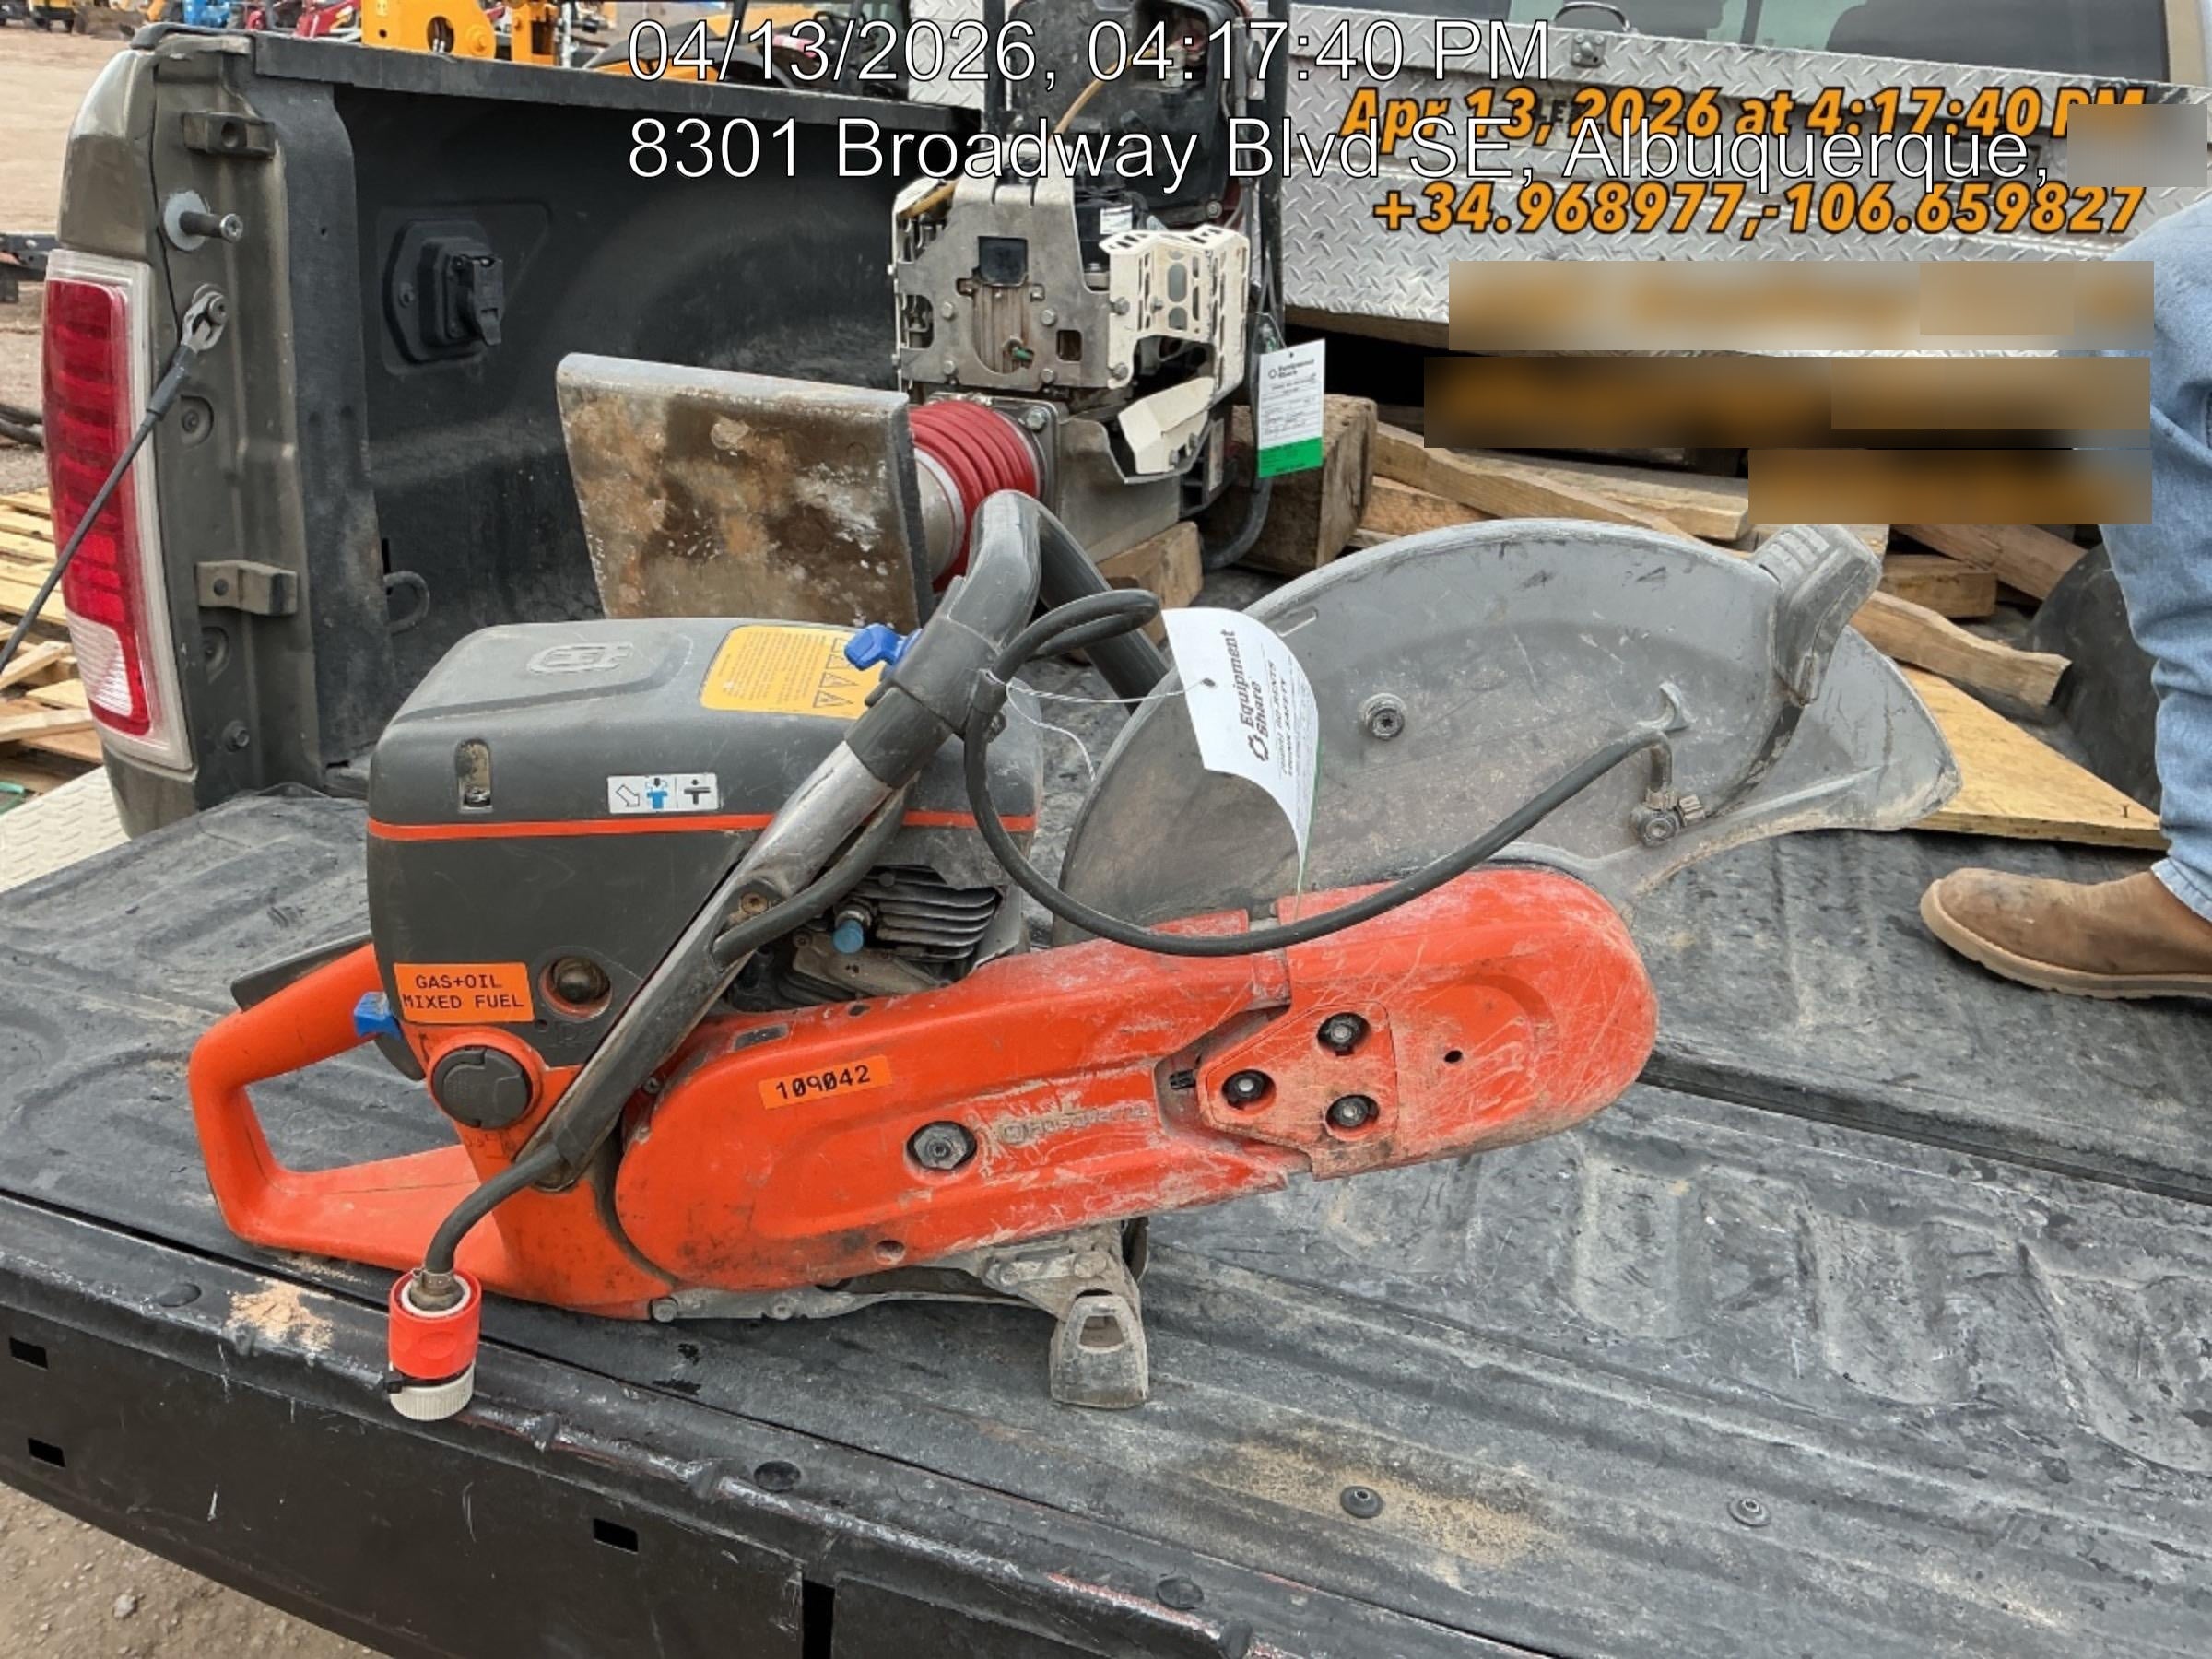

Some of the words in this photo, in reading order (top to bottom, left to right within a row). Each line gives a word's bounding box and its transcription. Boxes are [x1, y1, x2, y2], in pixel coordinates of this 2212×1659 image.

[1220, 629, 1254, 729] Equipment
[1251, 681, 1270, 738] Share
[415, 974, 502, 990] GAS+OIL
[403, 994, 462, 1009] MIXED
[474, 994, 524, 1008] FUEL
[775, 1064, 872, 1100] 109042
